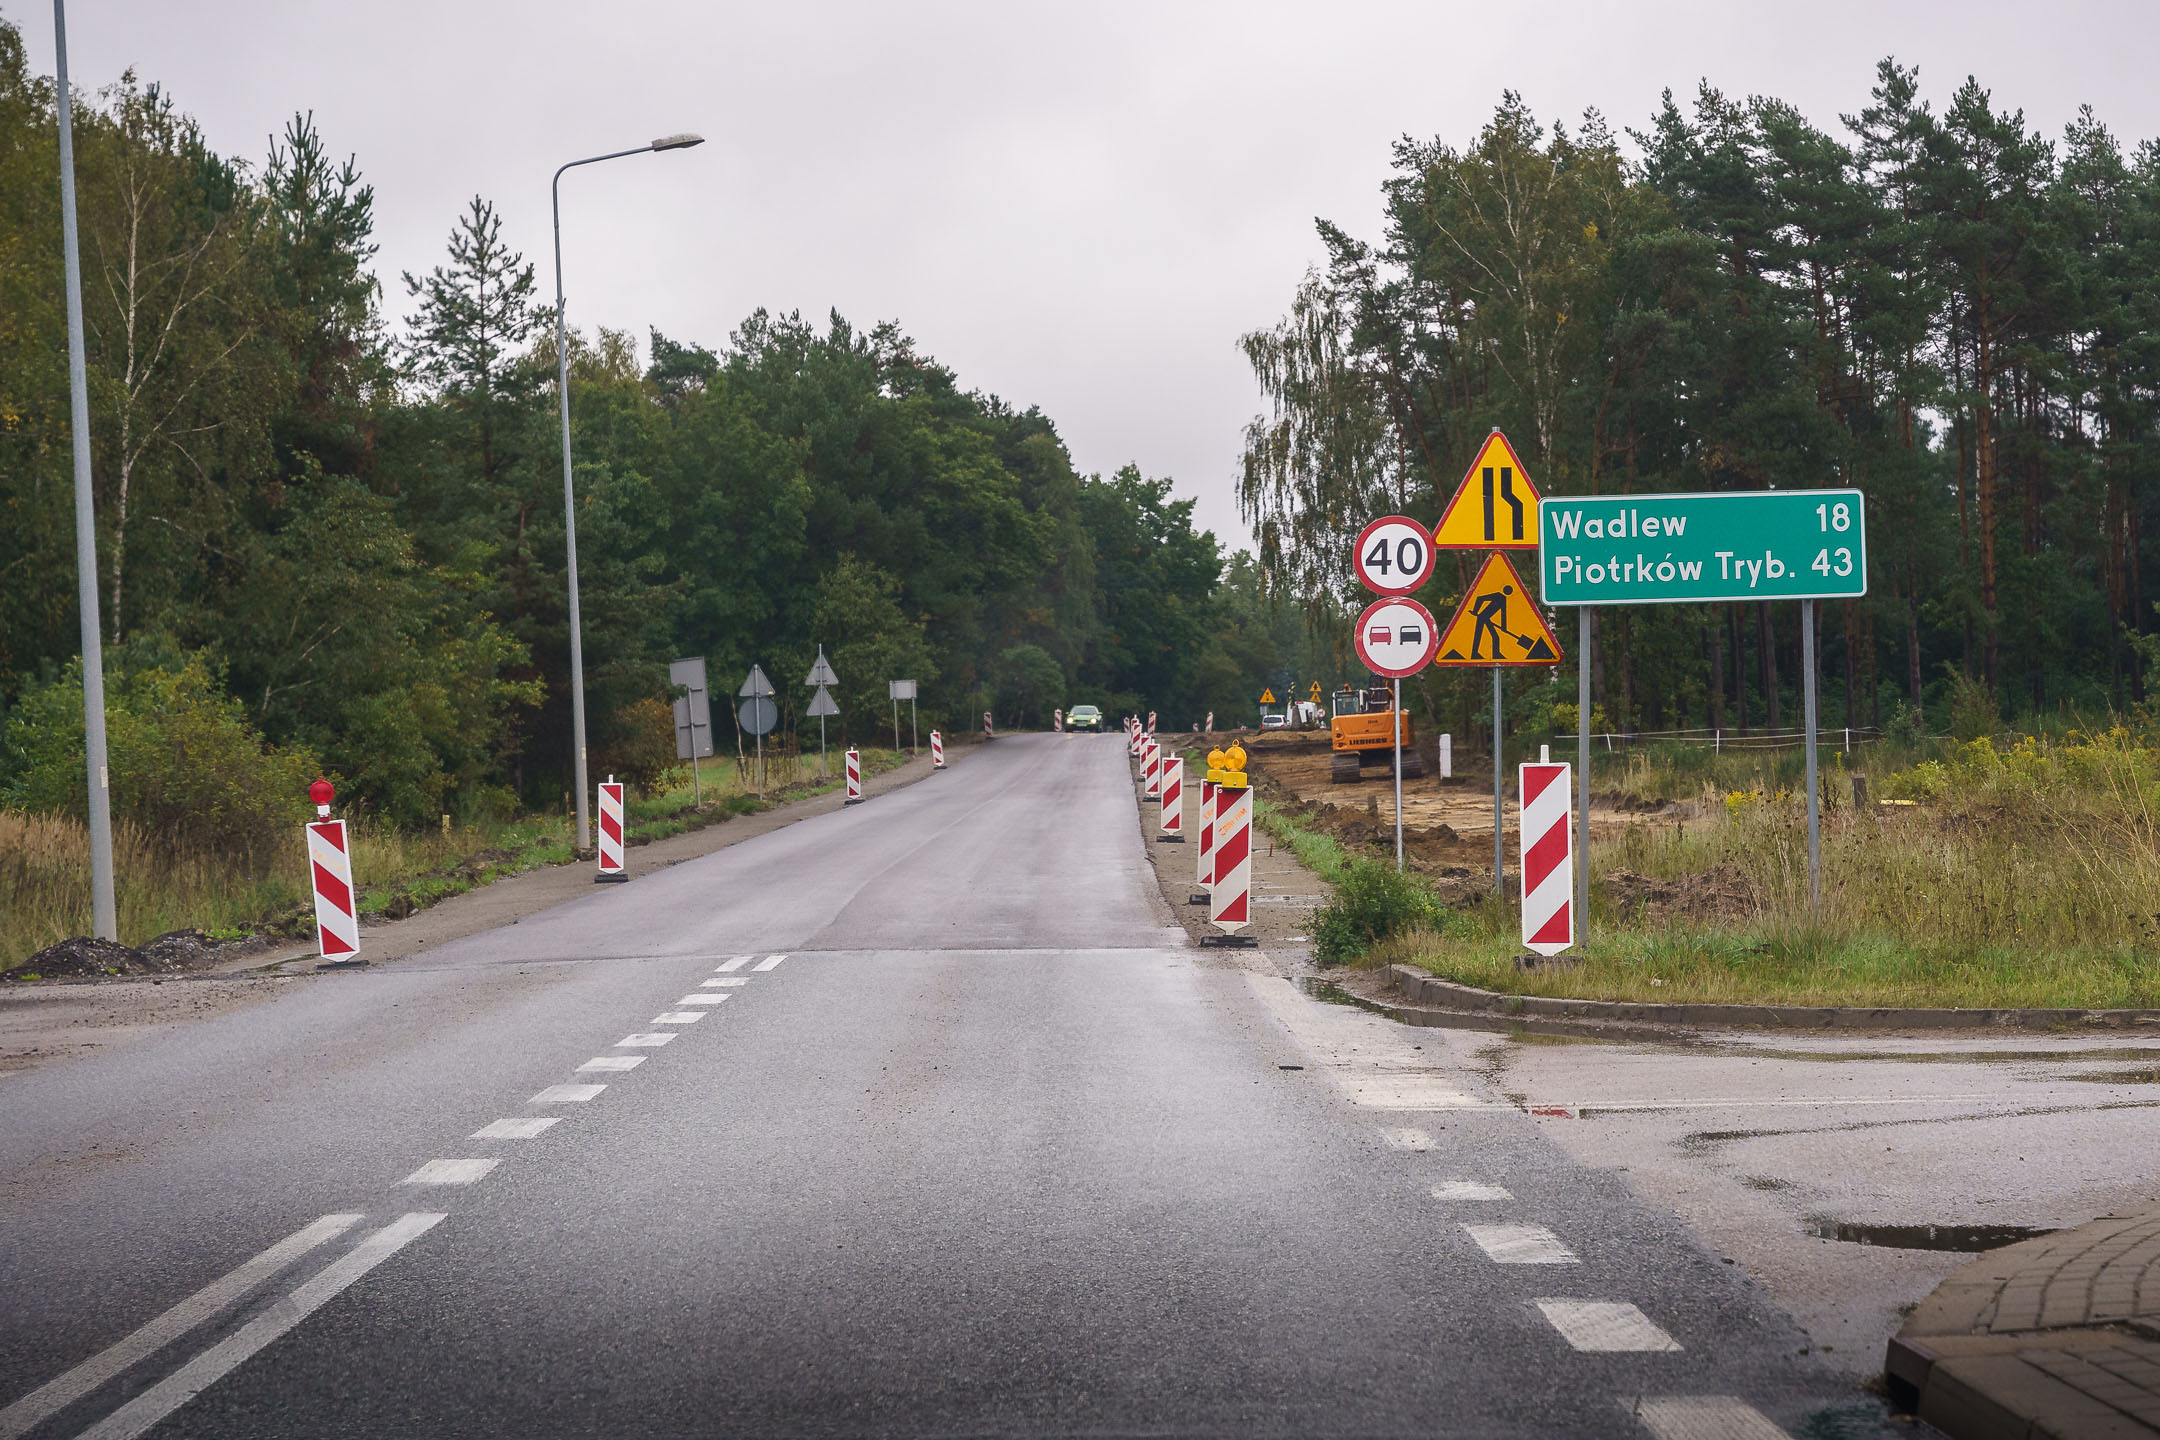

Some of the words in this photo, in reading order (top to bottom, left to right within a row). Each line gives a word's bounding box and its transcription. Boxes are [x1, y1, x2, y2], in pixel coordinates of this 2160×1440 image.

[1551, 509, 1687, 539] Wadlew
[1816, 502, 1851, 532] 18
[1365, 537, 1423, 576] 40
[1555, 552, 1703, 585] Piotrków
[1714, 550, 1795, 589] Tryb.
[1811, 547, 1852, 578] 43
